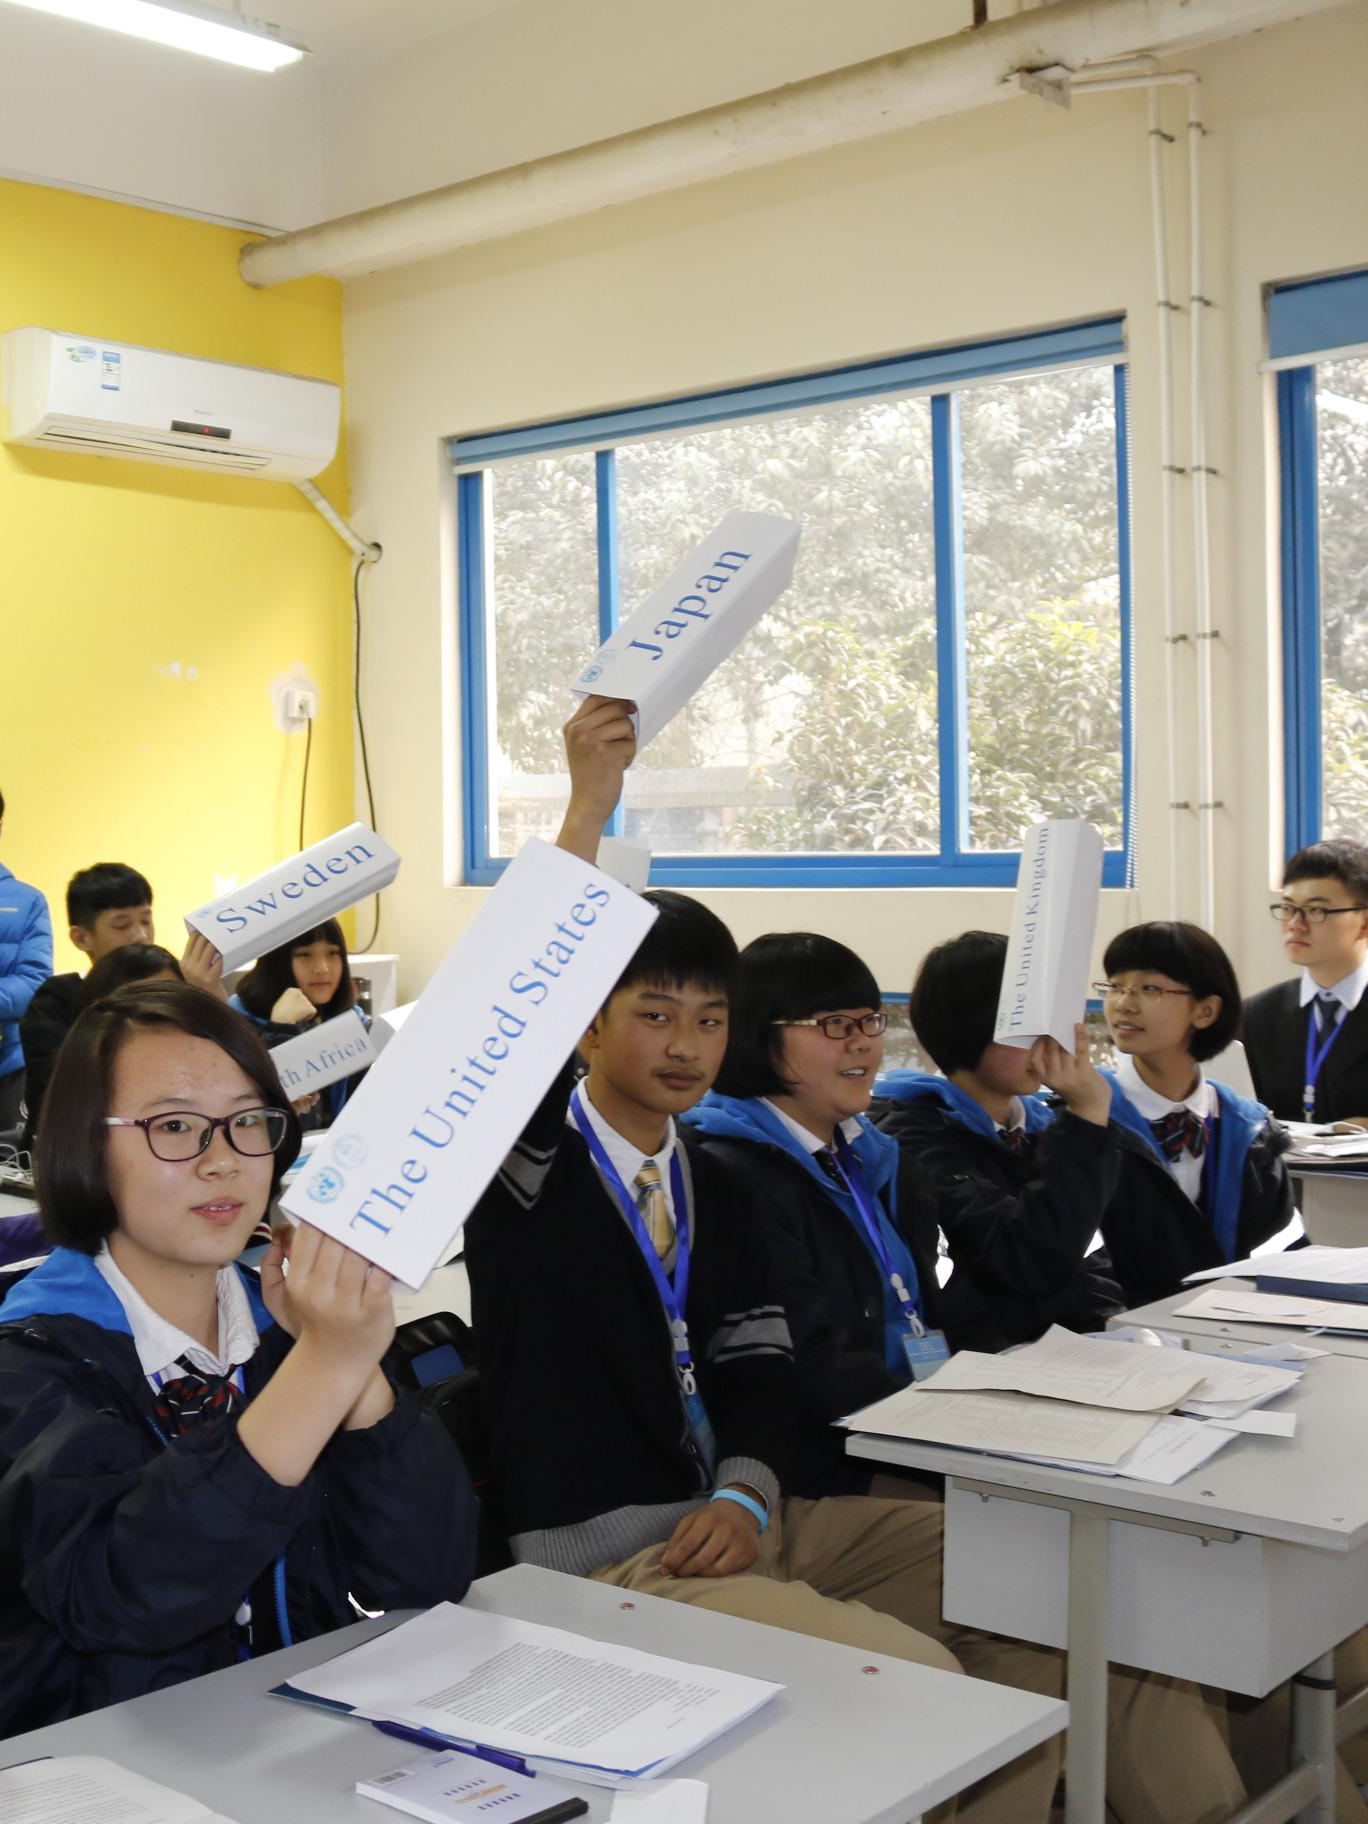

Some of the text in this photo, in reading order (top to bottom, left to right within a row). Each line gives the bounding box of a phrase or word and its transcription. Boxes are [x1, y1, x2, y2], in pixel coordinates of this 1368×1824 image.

[627, 550, 752, 661] Japan
[215, 843, 375, 934] Sweden
[1009, 827, 1050, 1032] The United Kingdom
[305, 1038, 368, 1078] Africa
[348, 882, 611, 1239] The United States
